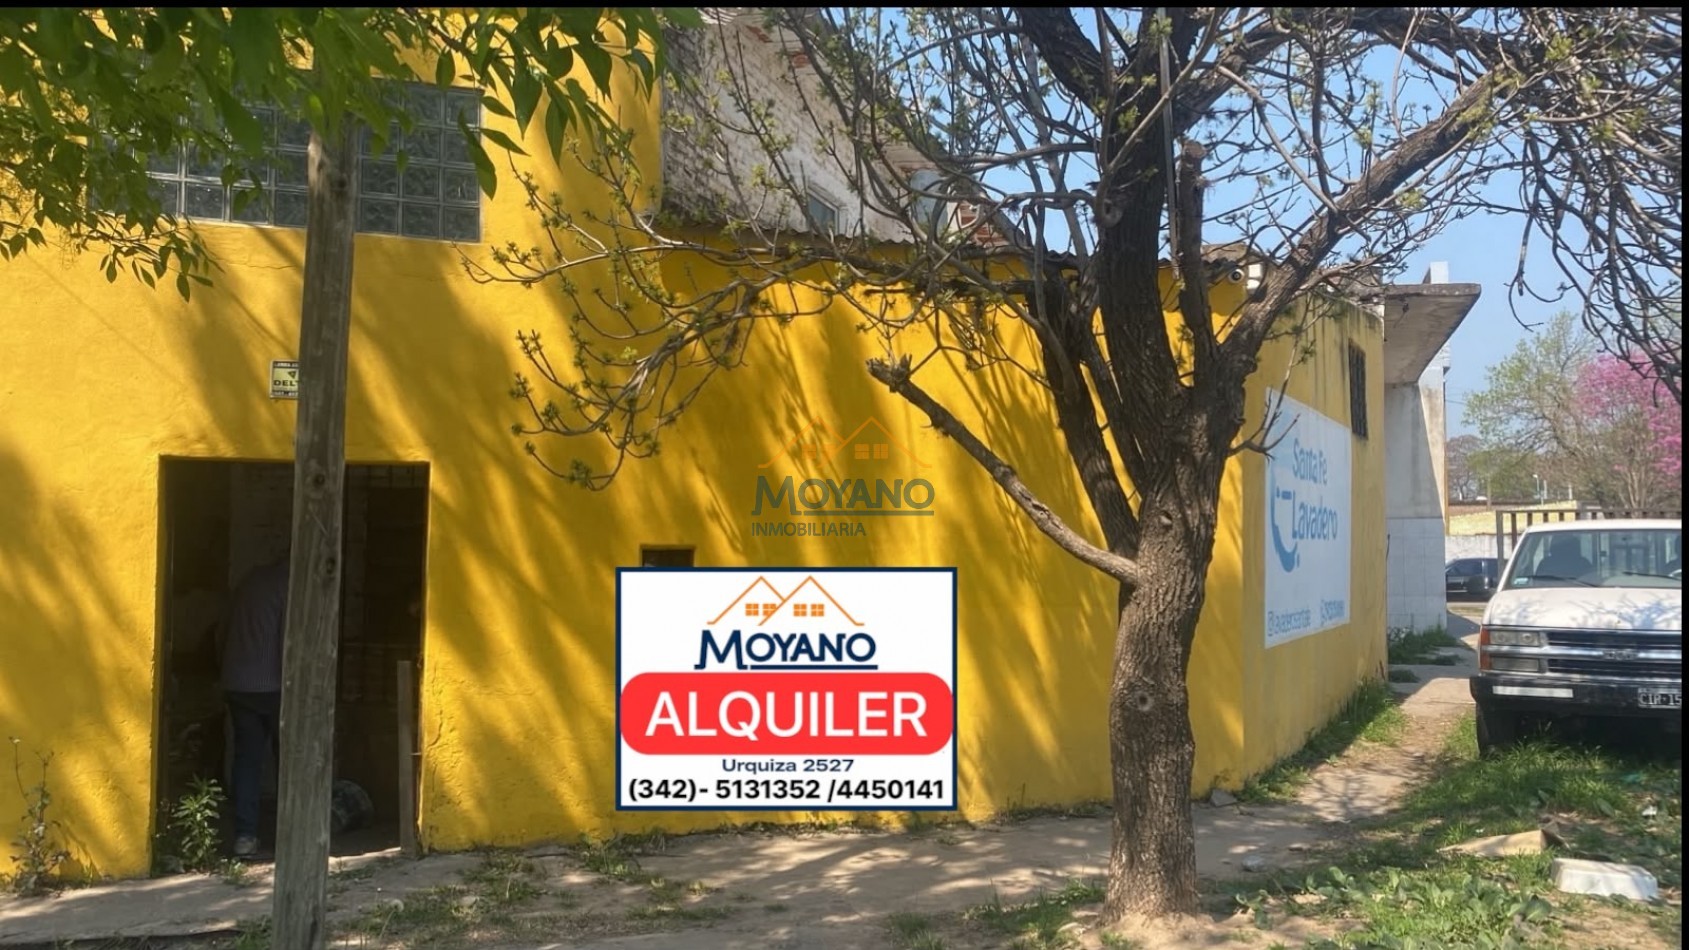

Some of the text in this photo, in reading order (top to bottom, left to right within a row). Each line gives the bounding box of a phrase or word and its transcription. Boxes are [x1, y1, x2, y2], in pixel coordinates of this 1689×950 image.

[1292, 437, 1328, 486] Santa Fe
[1292, 490, 1338, 541] Lavadero
